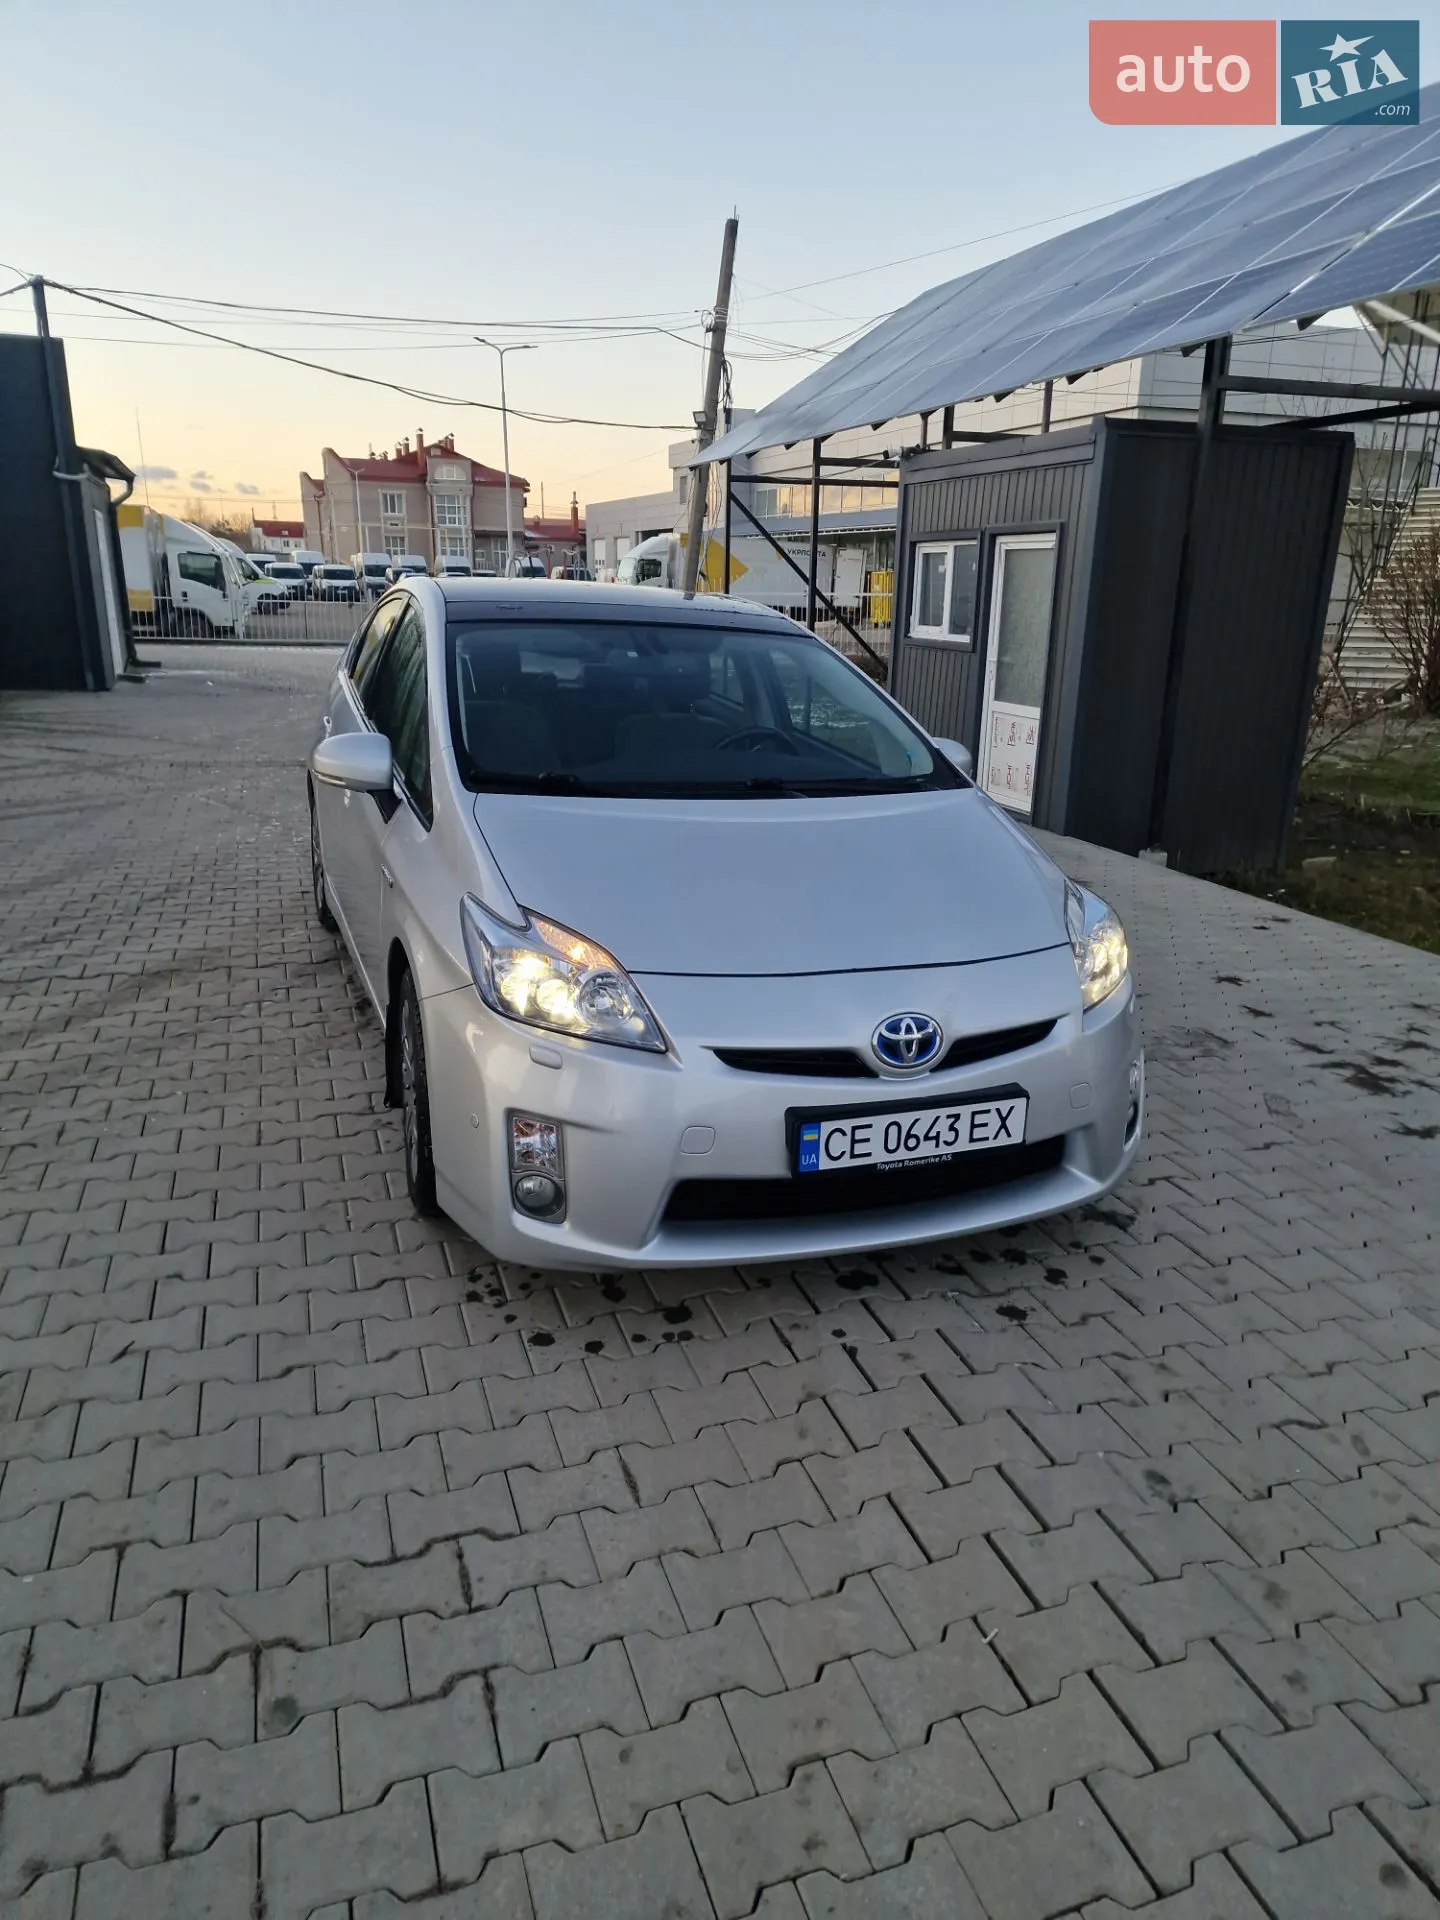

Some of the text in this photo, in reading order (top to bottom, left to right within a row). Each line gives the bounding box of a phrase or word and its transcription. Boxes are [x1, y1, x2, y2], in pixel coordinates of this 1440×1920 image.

[787, 548, 826, 557] УКРПОТА
[824, 1105, 1016, 1161] CE 0643 EX
[801, 1154, 817, 1166] UA
[876, 1153, 952, 1171] Toyota Romerike AS
